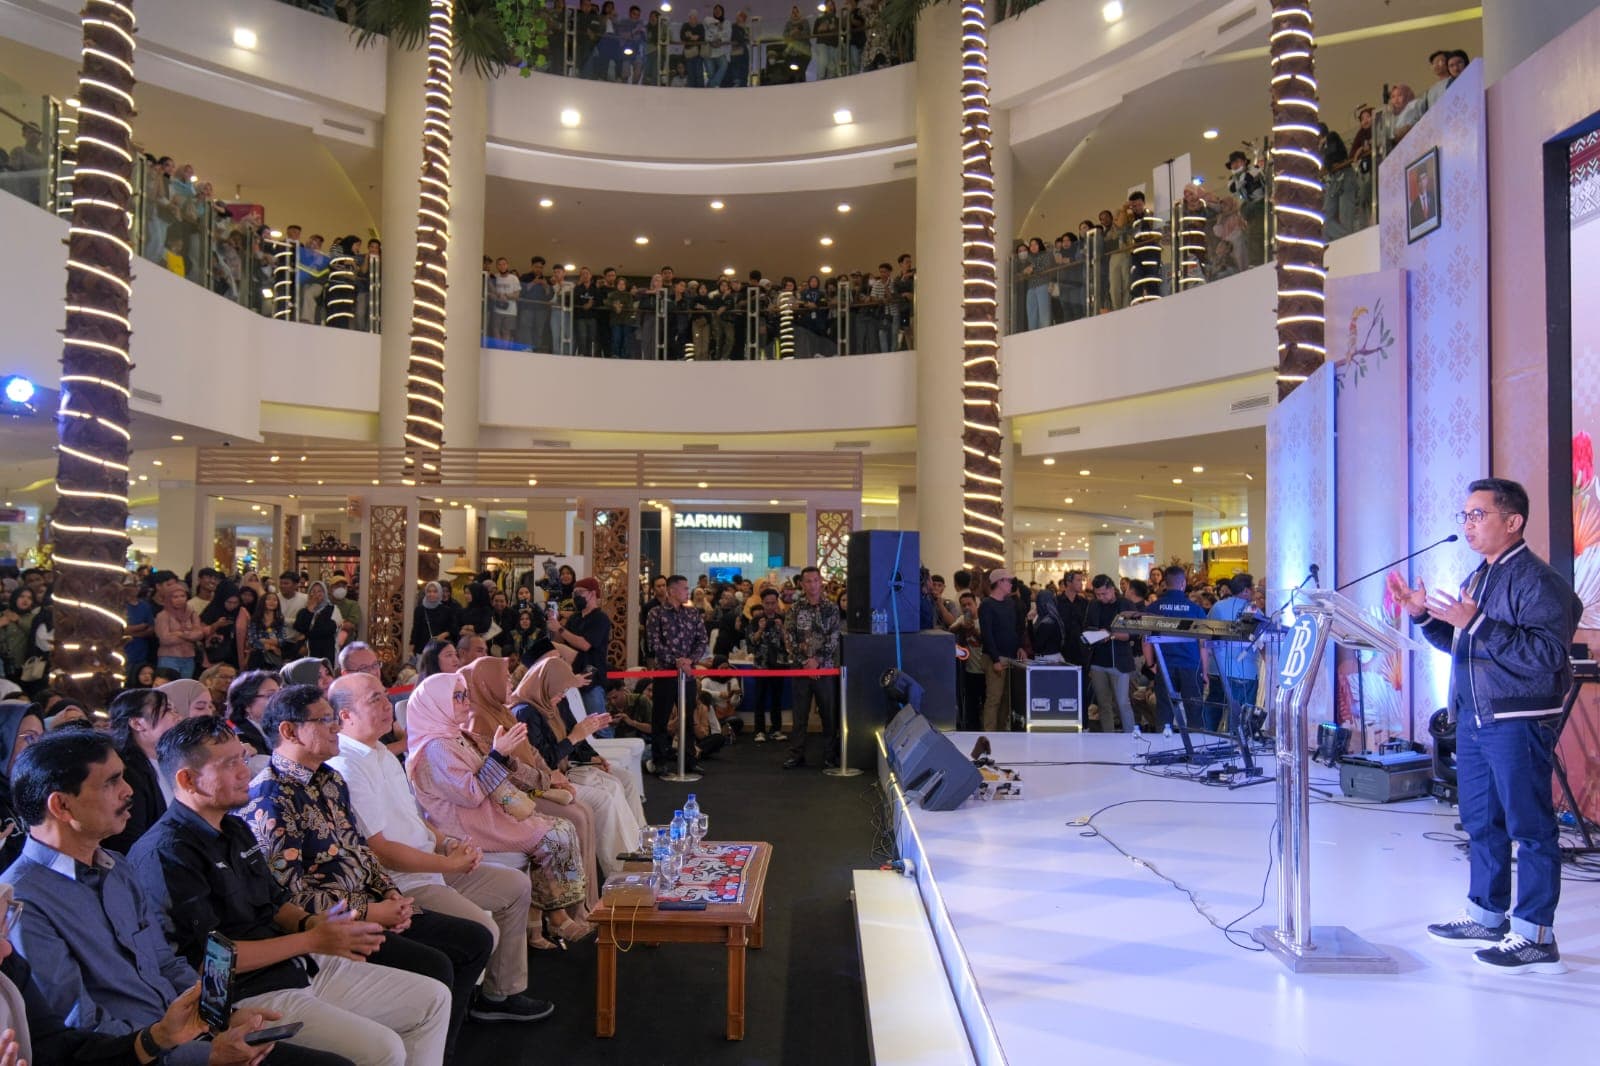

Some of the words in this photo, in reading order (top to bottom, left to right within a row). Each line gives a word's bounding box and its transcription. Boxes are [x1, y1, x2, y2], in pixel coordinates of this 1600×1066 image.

[674, 513, 742, 529] GARMIN
[699, 552, 754, 563] GARMIN
[1155, 621, 1180, 630] Roland
